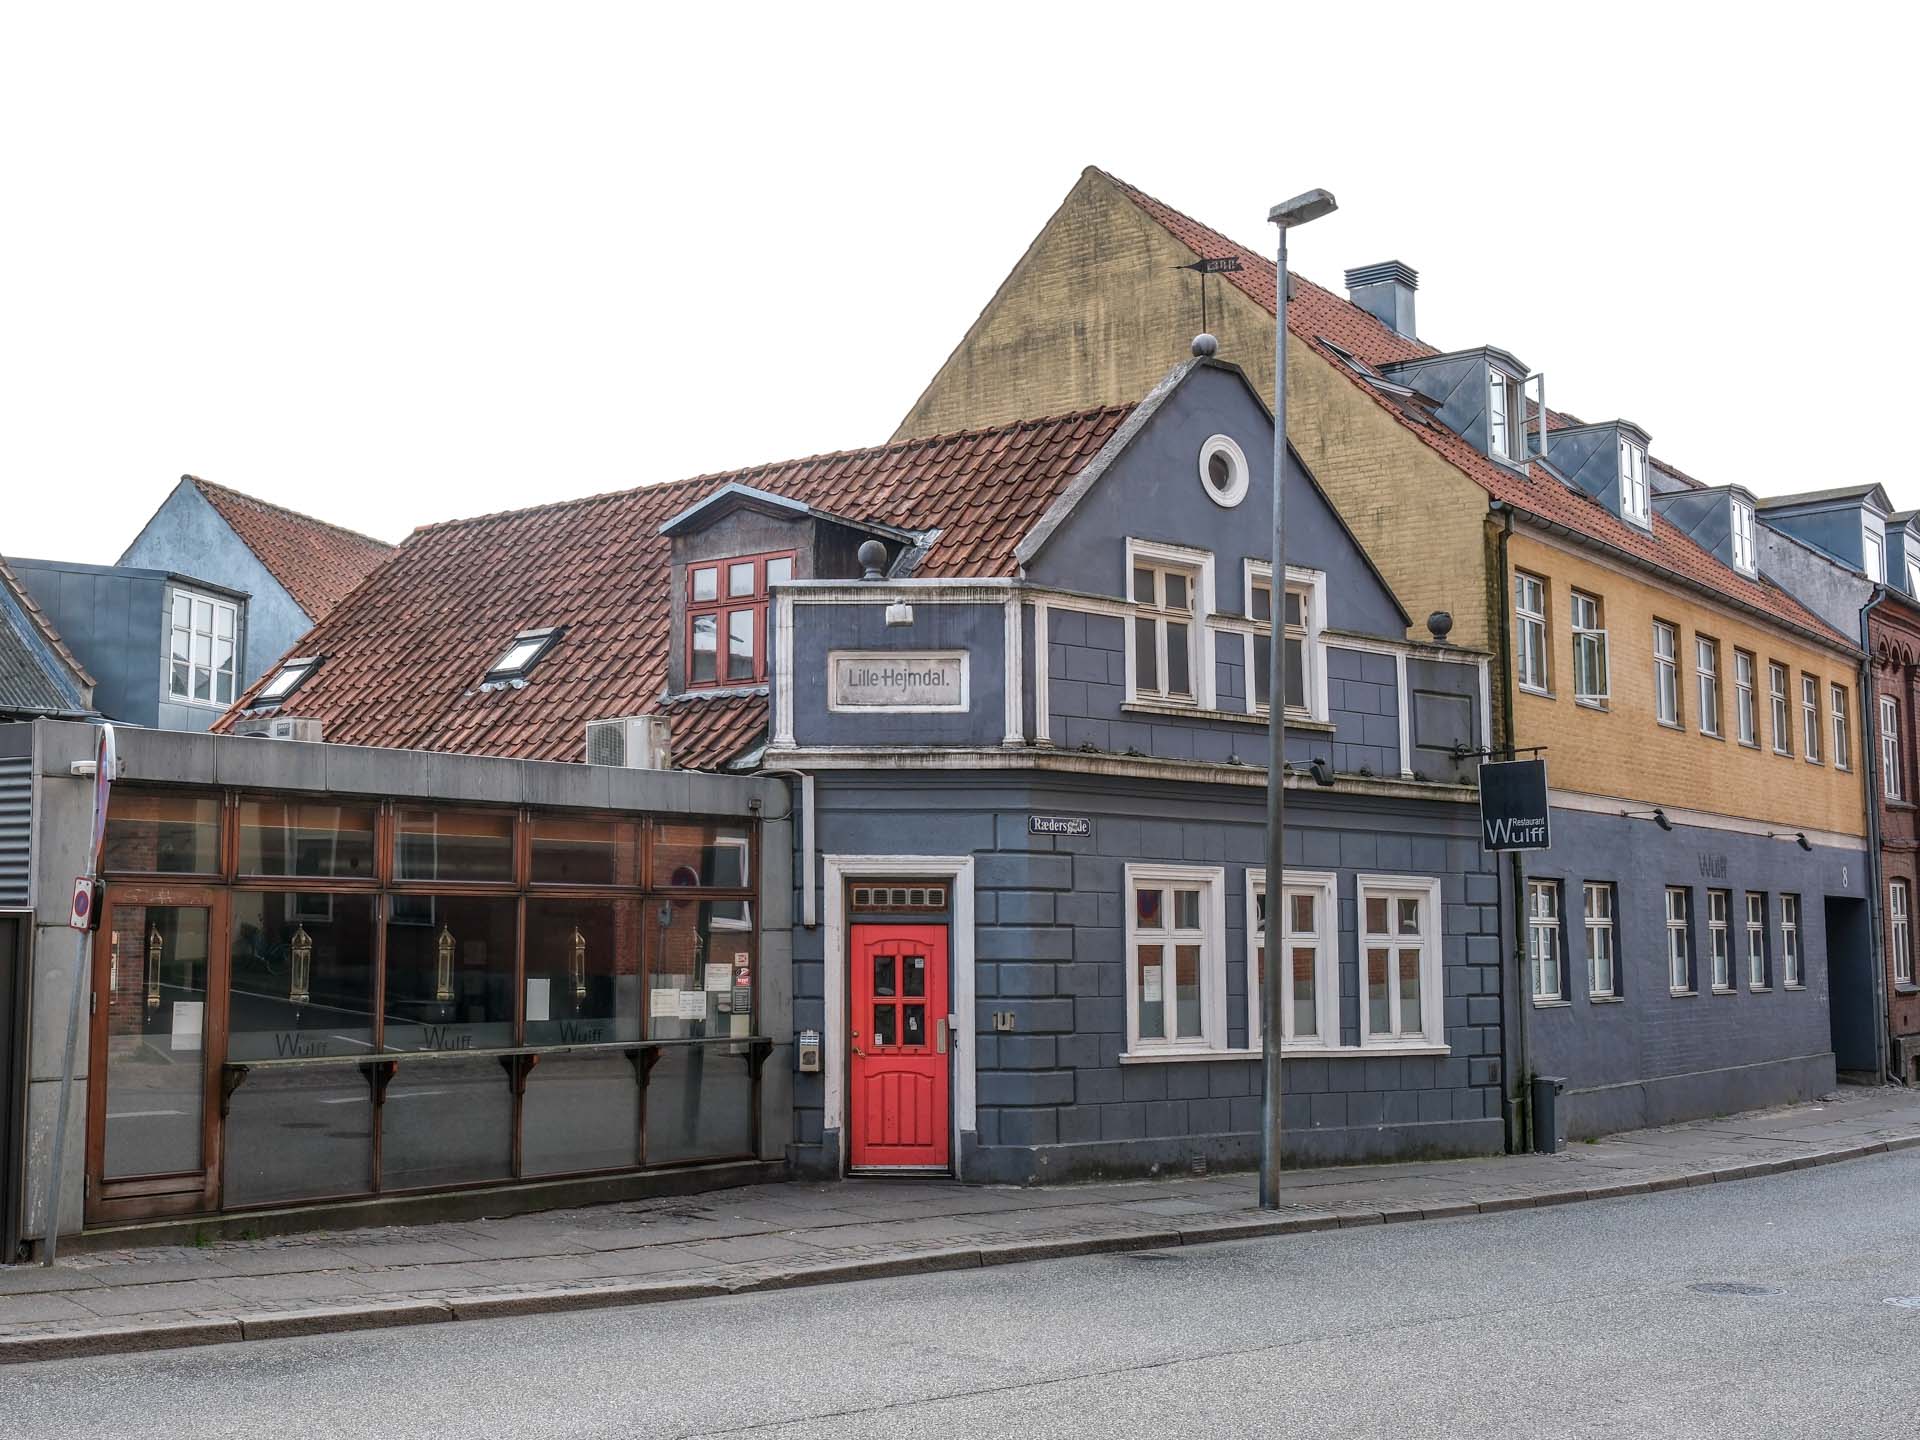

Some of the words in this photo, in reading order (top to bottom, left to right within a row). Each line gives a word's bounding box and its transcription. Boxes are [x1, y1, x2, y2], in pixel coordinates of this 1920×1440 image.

[849, 669, 879, 687] Lille
[1486, 818, 1545, 844] Wulff
[1512, 817, 1545, 826] Restaurant
[1841, 866, 1848, 888] 8
[424, 1026, 472, 1050] Wulff
[559, 1022, 604, 1042] Wulff
[276, 1033, 328, 1057] Wulff
